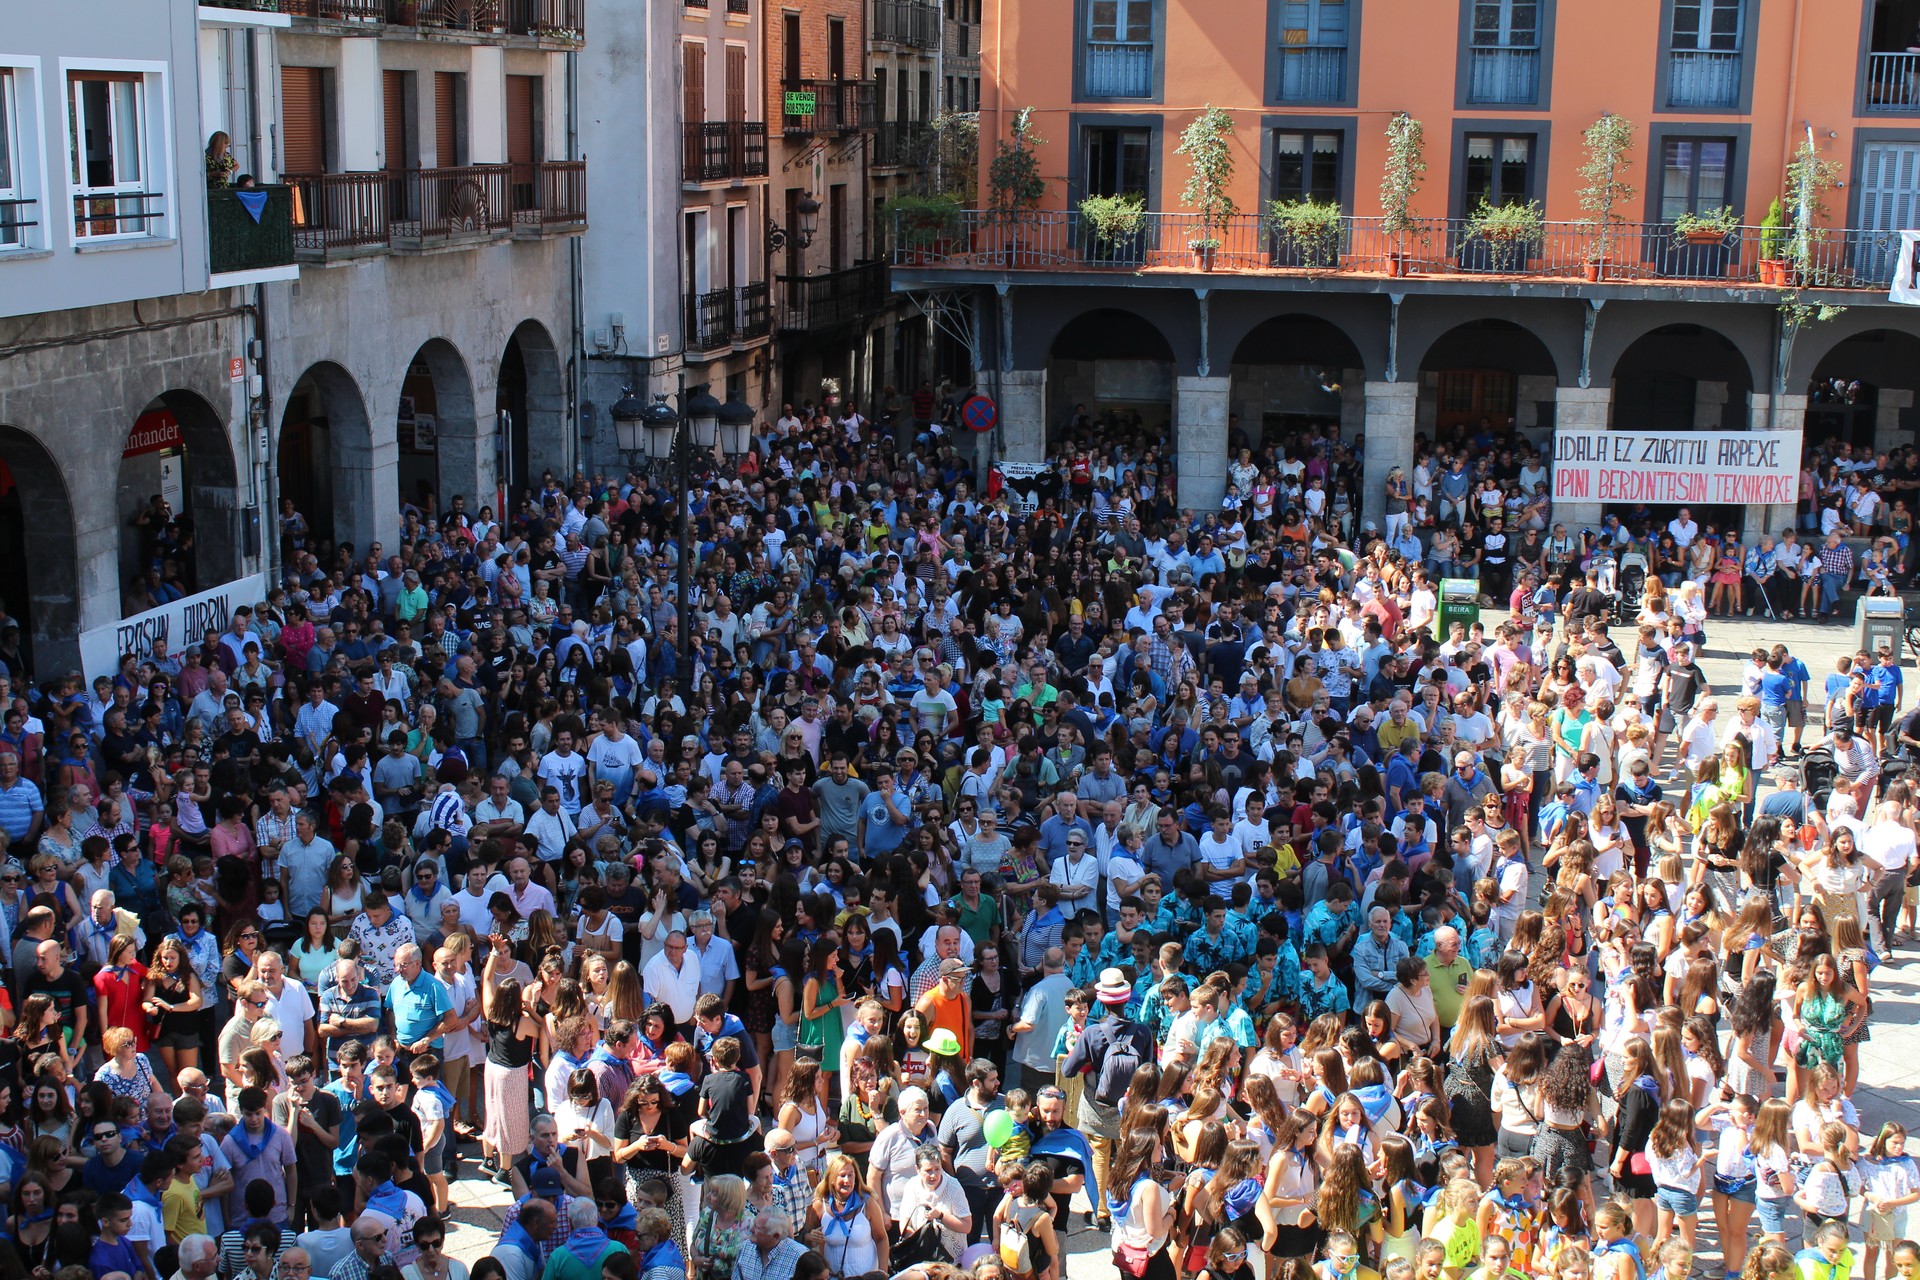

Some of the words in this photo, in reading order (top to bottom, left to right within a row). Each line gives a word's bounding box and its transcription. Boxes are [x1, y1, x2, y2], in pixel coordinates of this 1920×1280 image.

[795, 93, 815, 101] VENDE
[1554, 436, 1608, 461] UDALA
[1614, 437, 1634, 462] EZ
[1640, 438, 1707, 465] ZURITTU
[1718, 439, 1780, 467] ARPEXE
[1556, 469, 1589, 497] IPINI
[1598, 469, 1708, 502] BERDINTASUN
[1714, 474, 1793, 503] TEKNIKAXE
